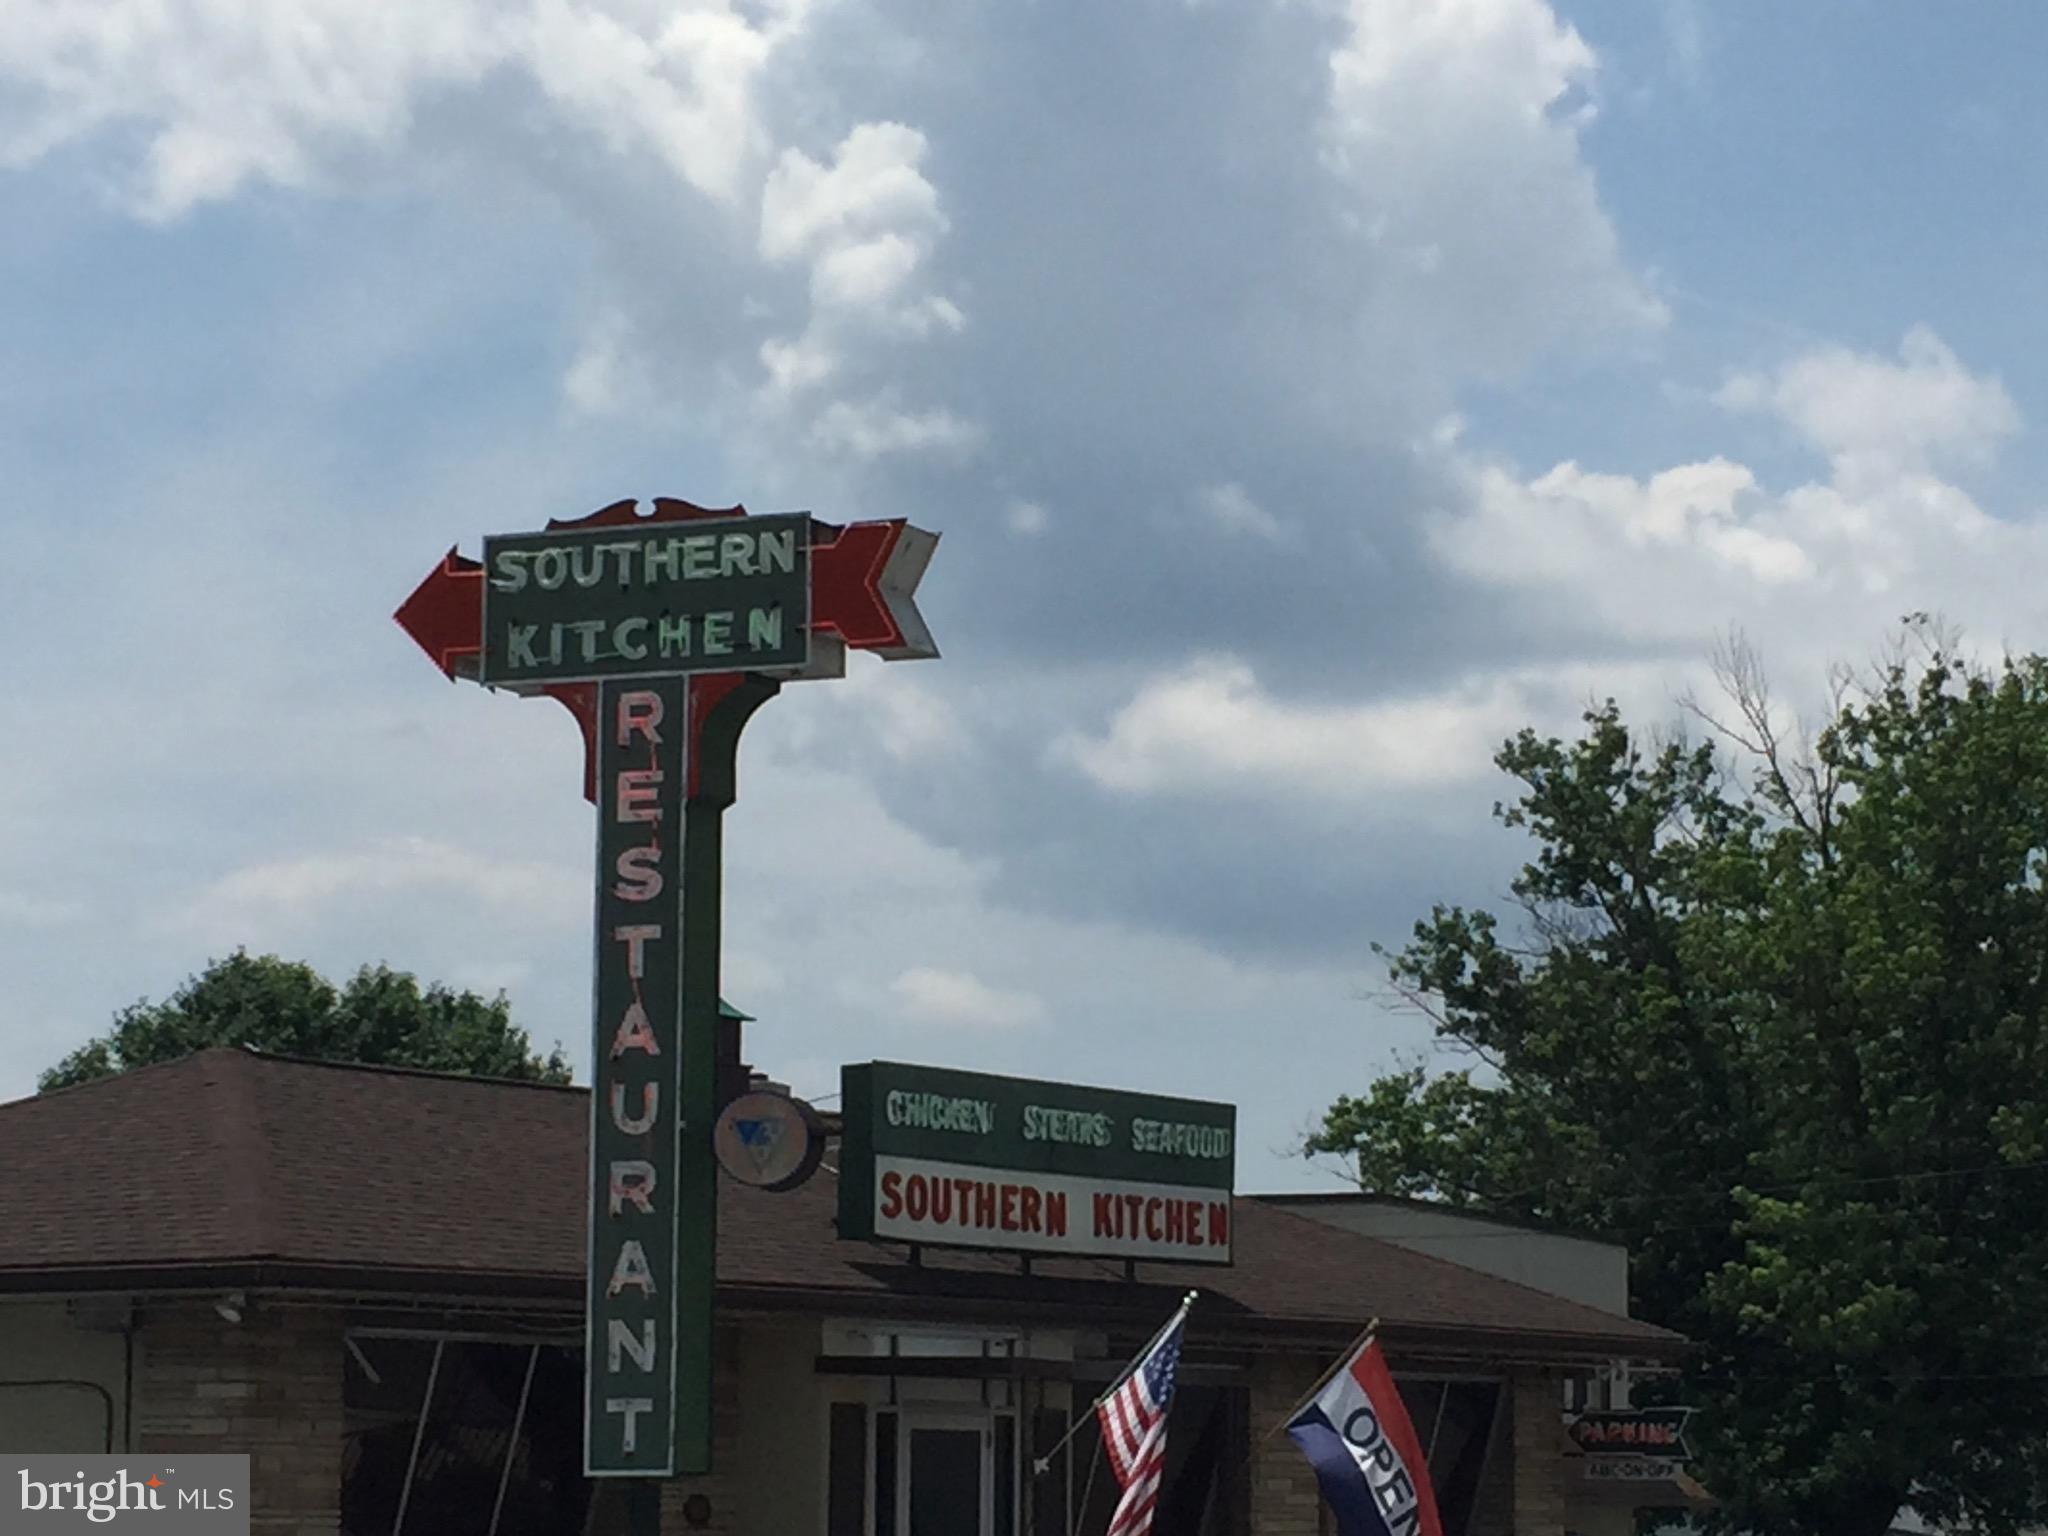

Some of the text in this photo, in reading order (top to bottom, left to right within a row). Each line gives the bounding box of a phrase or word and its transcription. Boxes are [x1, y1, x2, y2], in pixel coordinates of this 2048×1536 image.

[490, 529, 796, 593] SOUTHERN
[507, 606, 783, 668] KITCHEN
[606, 690, 664, 1453] RESTAURANT
[886, 1089, 1231, 1158] CHICKEN STEAKS SEAFOOD
[880, 1170, 1228, 1246] SOUTHERN KITCHEN
[1580, 1420, 1678, 1445] PARKING
